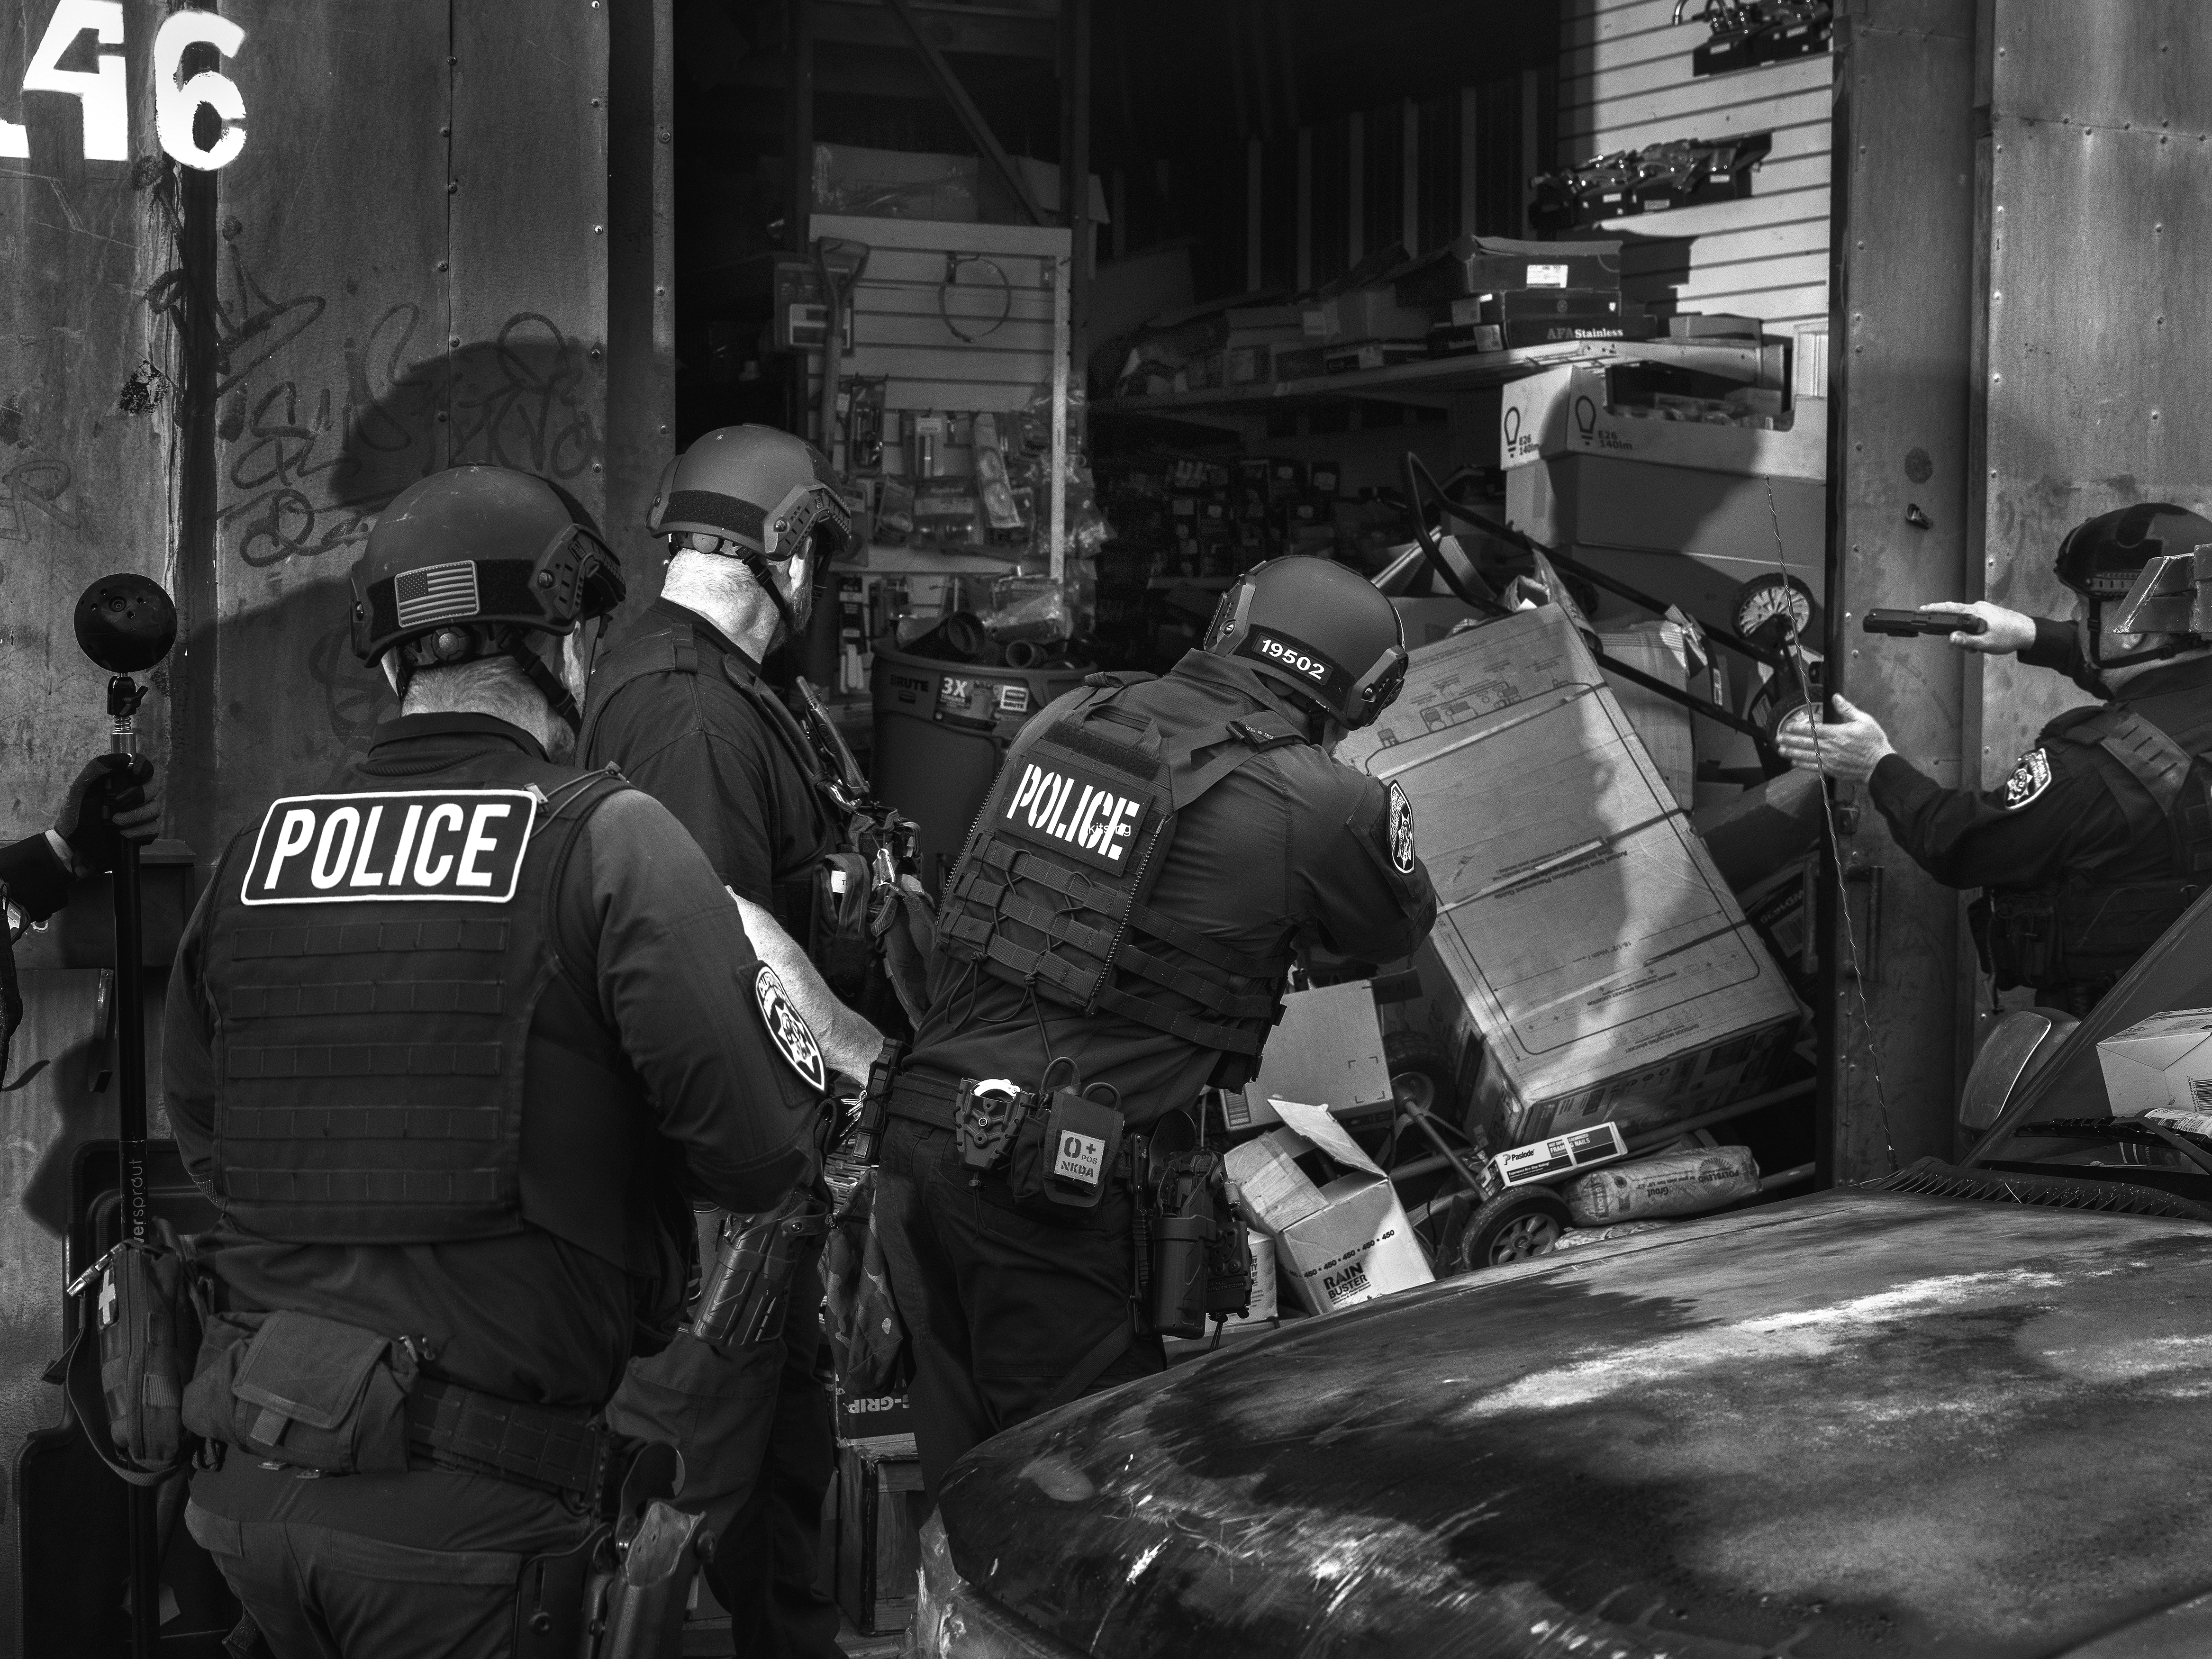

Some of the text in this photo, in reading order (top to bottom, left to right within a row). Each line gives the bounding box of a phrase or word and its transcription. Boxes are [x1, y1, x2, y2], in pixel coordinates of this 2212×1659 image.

[0, 0, 247, 171] 46
[1598, 430, 1617, 439] E26
[1600, 440, 1632, 450] 140lm
[1261, 638, 1326, 680] 19502
[891, 674, 929, 692] BRUTE
[941, 677, 968, 698] 3X
[1006, 763, 1140, 861] POLICE
[264, 803, 511, 890] POLICE
[1551, 862, 1590, 881] Installation
[1515, 875, 1551, 894] Placement
[1574, 1137, 1591, 1147] NAILS
[1081, 1154, 1097, 1164] POS
[1510, 1148, 1535, 1161] Paslode
[1061, 1161, 1094, 1178] NKDA
[1697, 1169, 1739, 1182] POLYBLEND
[1646, 1185, 1669, 1198] Grout
[1304, 1269, 1317, 1278] 450
[1324, 1260, 1337, 1270] 450
[1342, 1250, 1356, 1260] 450
[1362, 1240, 1375, 1251] 450
[1382, 1230, 1395, 1240] 450
[1323, 1262, 1364, 1290] RAIN
[1328, 1274, 1368, 1299] BUSTER
